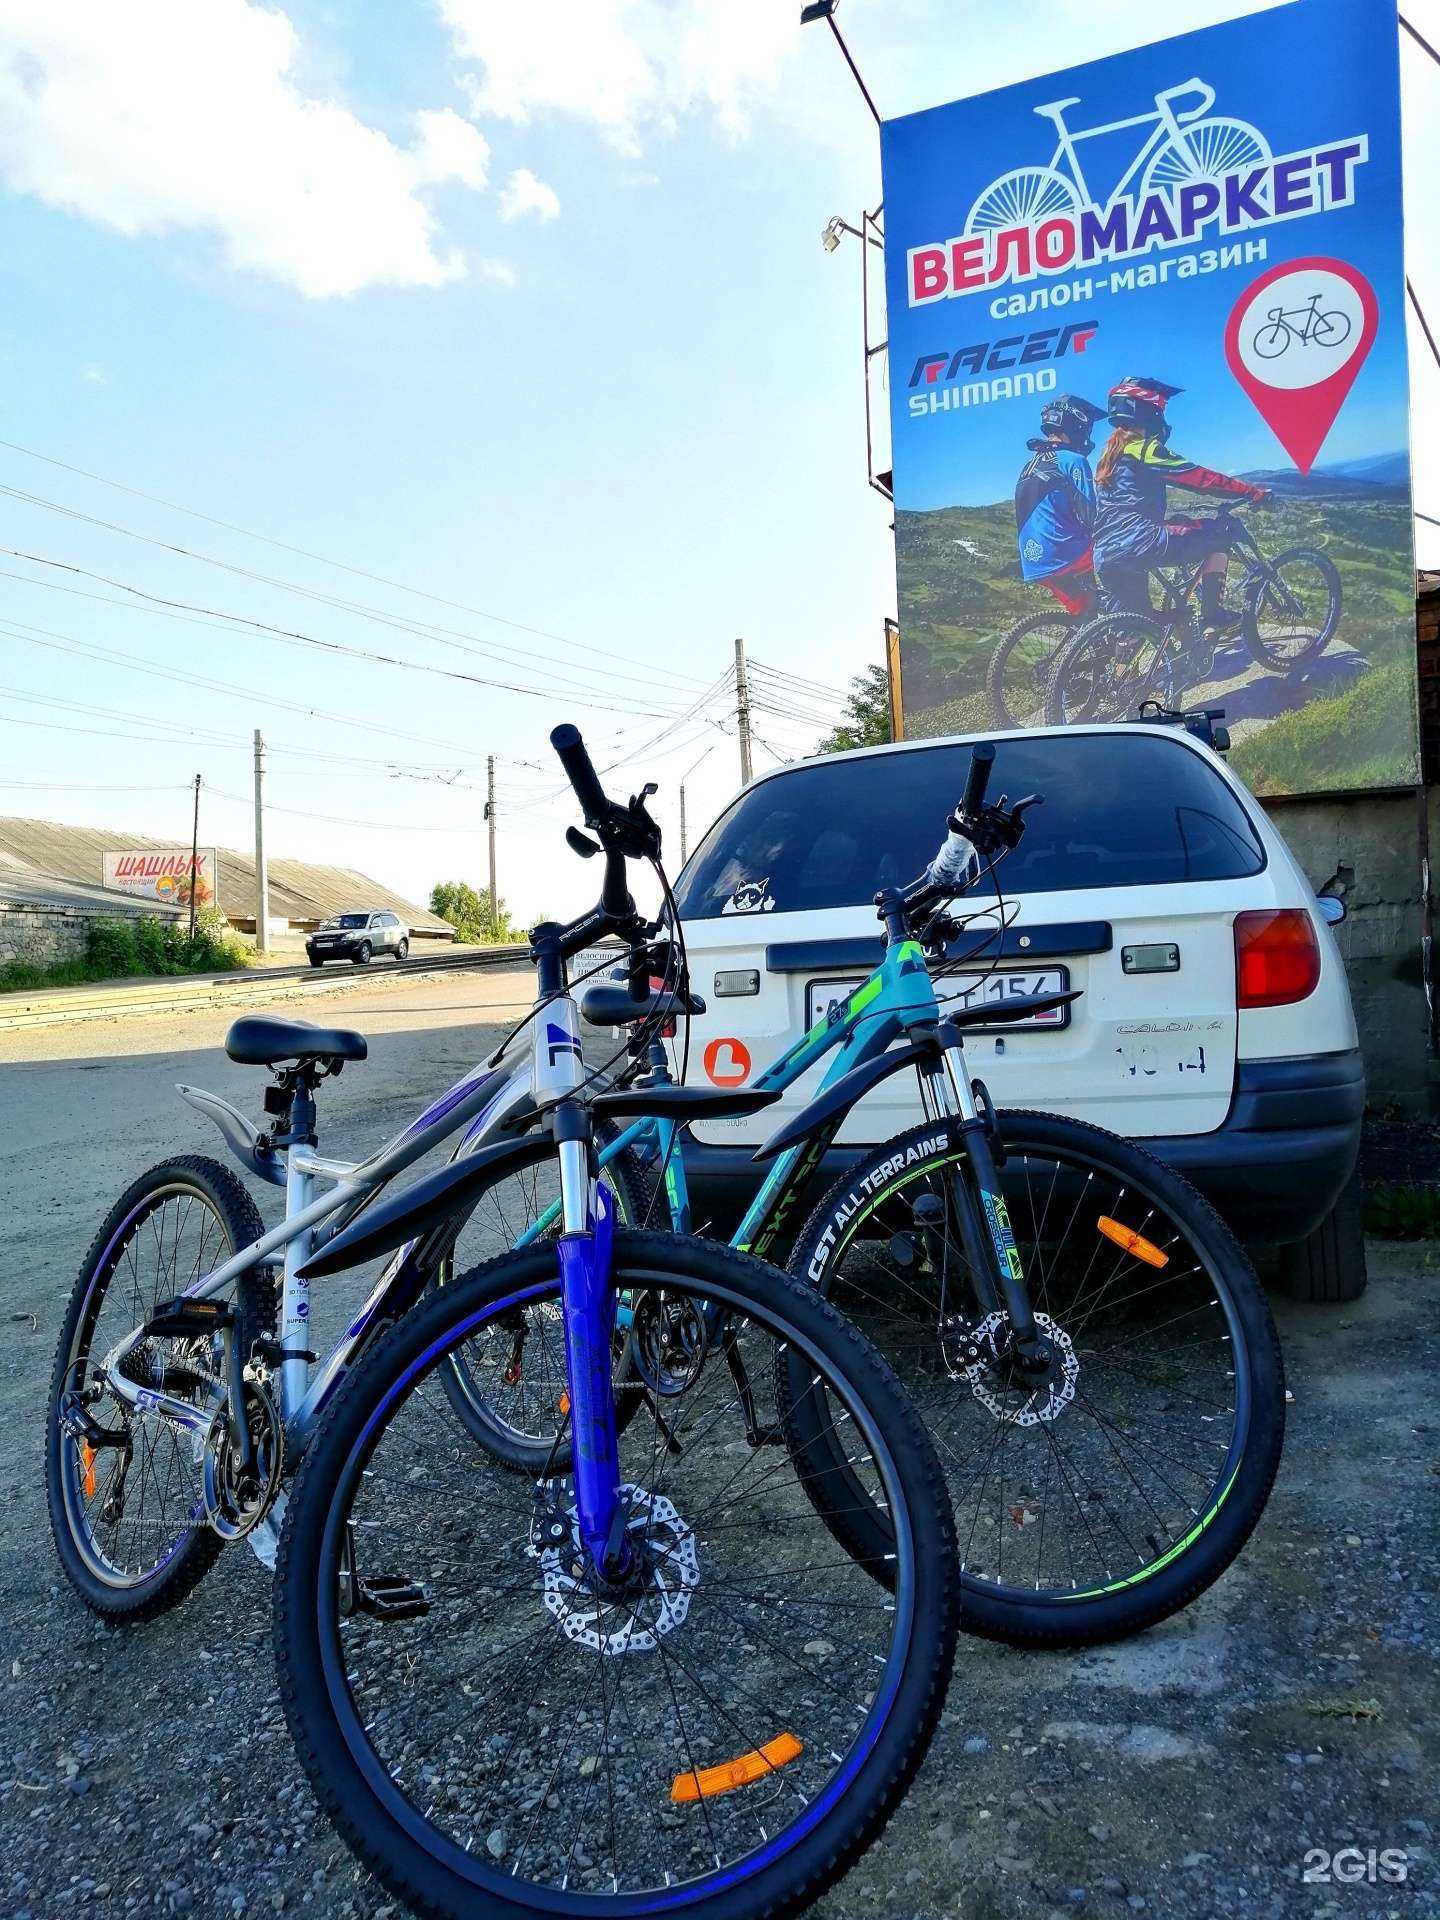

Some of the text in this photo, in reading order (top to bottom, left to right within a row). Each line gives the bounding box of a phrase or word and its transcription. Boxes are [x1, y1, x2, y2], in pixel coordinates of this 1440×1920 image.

[909, 138, 1366, 305] ВЕЛОМАРКЕТ
[989, 238, 1268, 320] салон-магазин
[909, 320, 1099, 388] RACER
[908, 368, 1057, 418] SHIMANO
[115, 854, 207, 877] ШАШЛЫК
[807, 1134, 949, 1282] CST ALL TERRAINS
